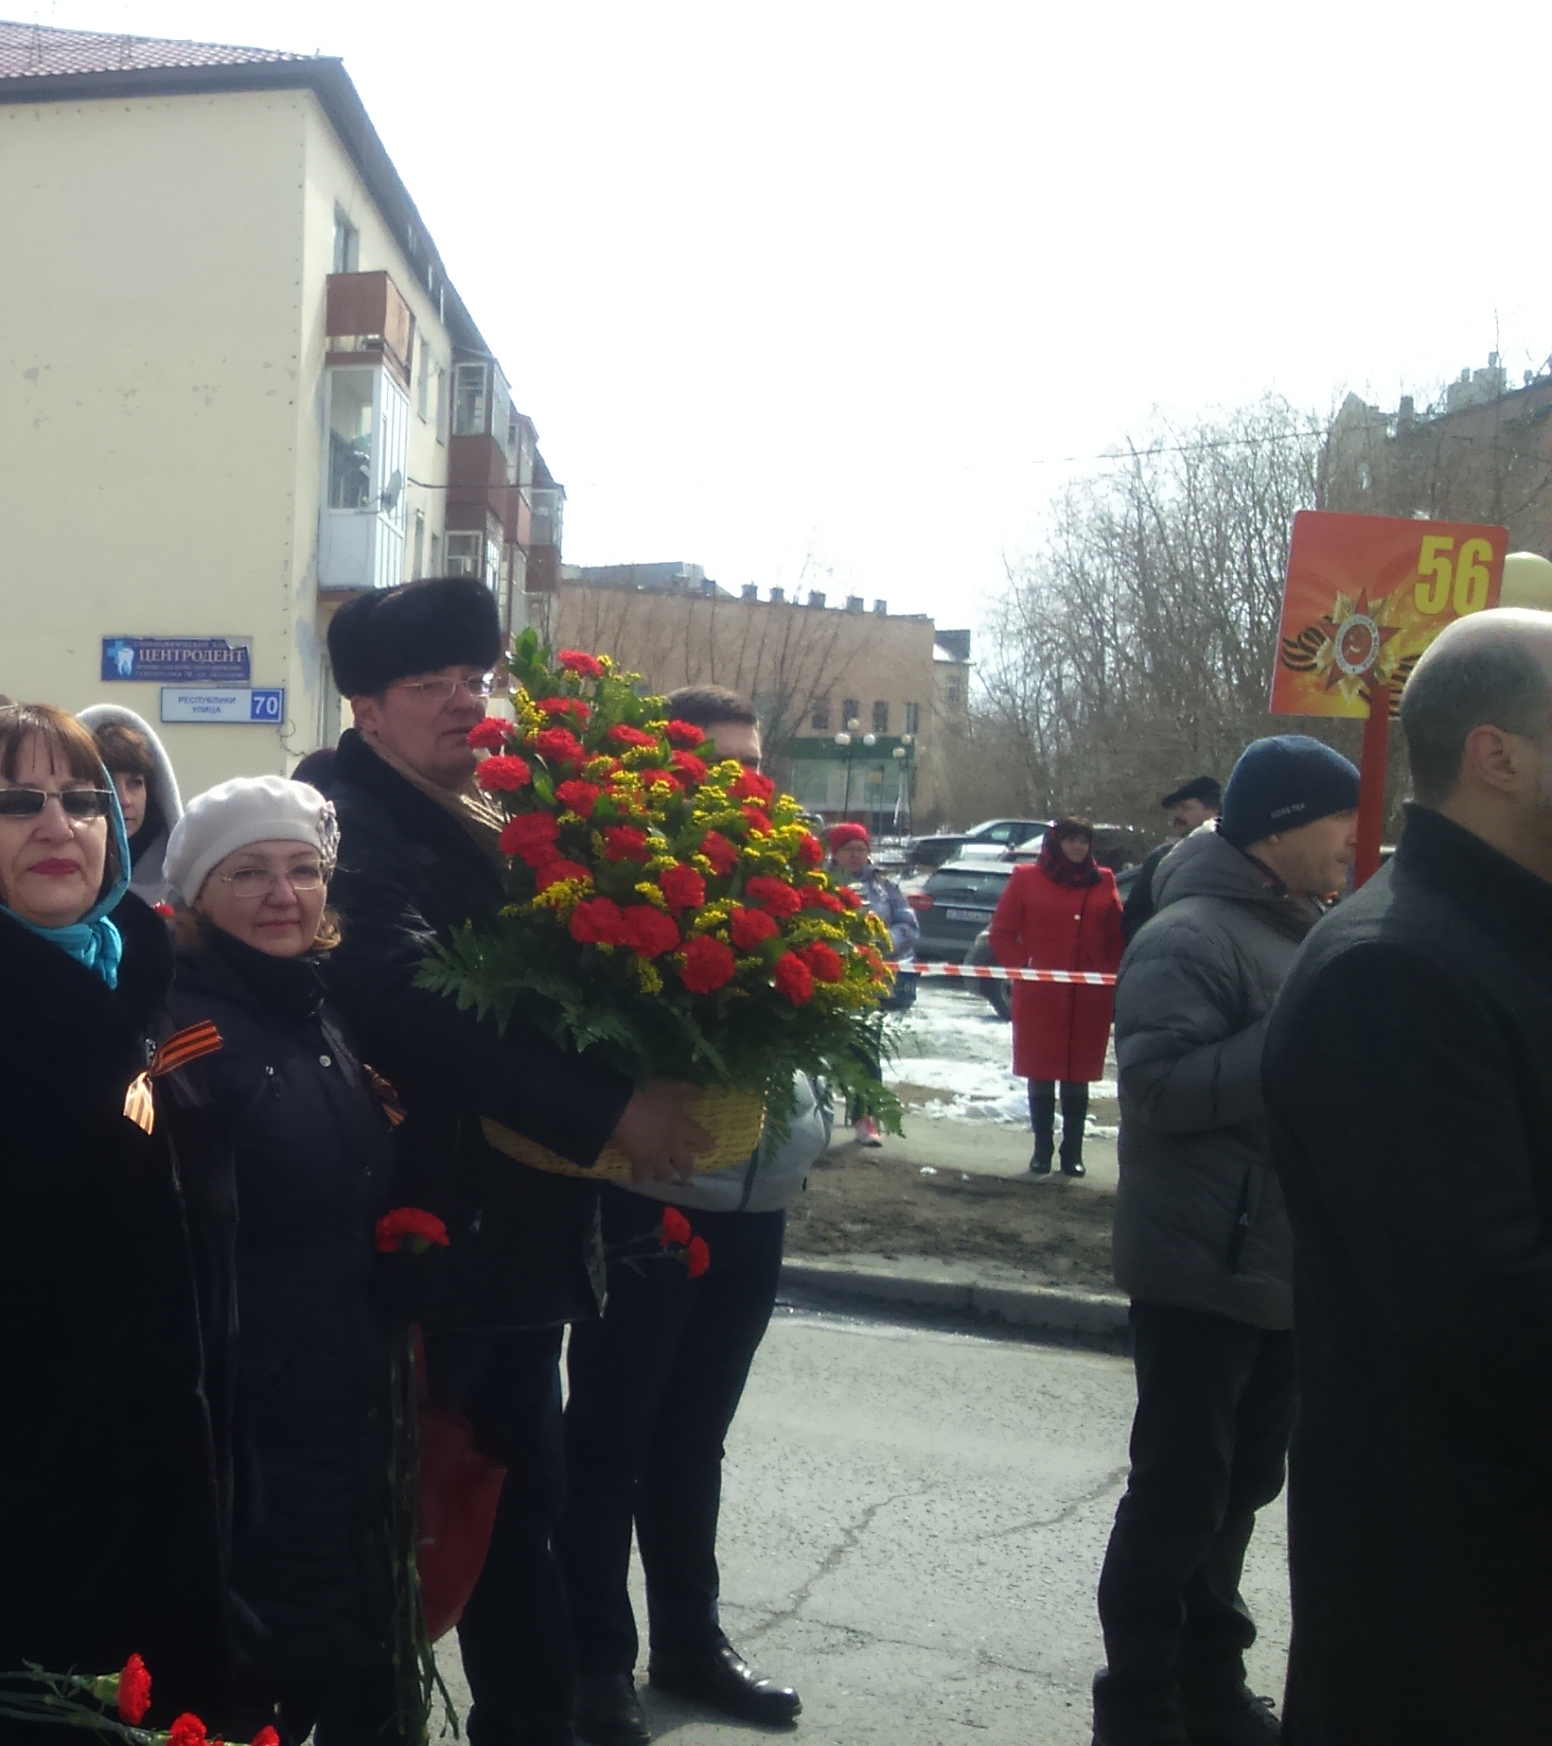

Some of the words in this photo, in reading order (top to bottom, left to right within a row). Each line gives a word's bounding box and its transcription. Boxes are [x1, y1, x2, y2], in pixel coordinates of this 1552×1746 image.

[1414, 535, 1493, 615] 56
[139, 650, 245, 663] ЦЕНТРОДЕНТ
[178, 696, 236, 704] РЕСПУБЛИКИ
[254, 697, 278, 715] 70
[192, 706, 221, 714] УЛИЦА
